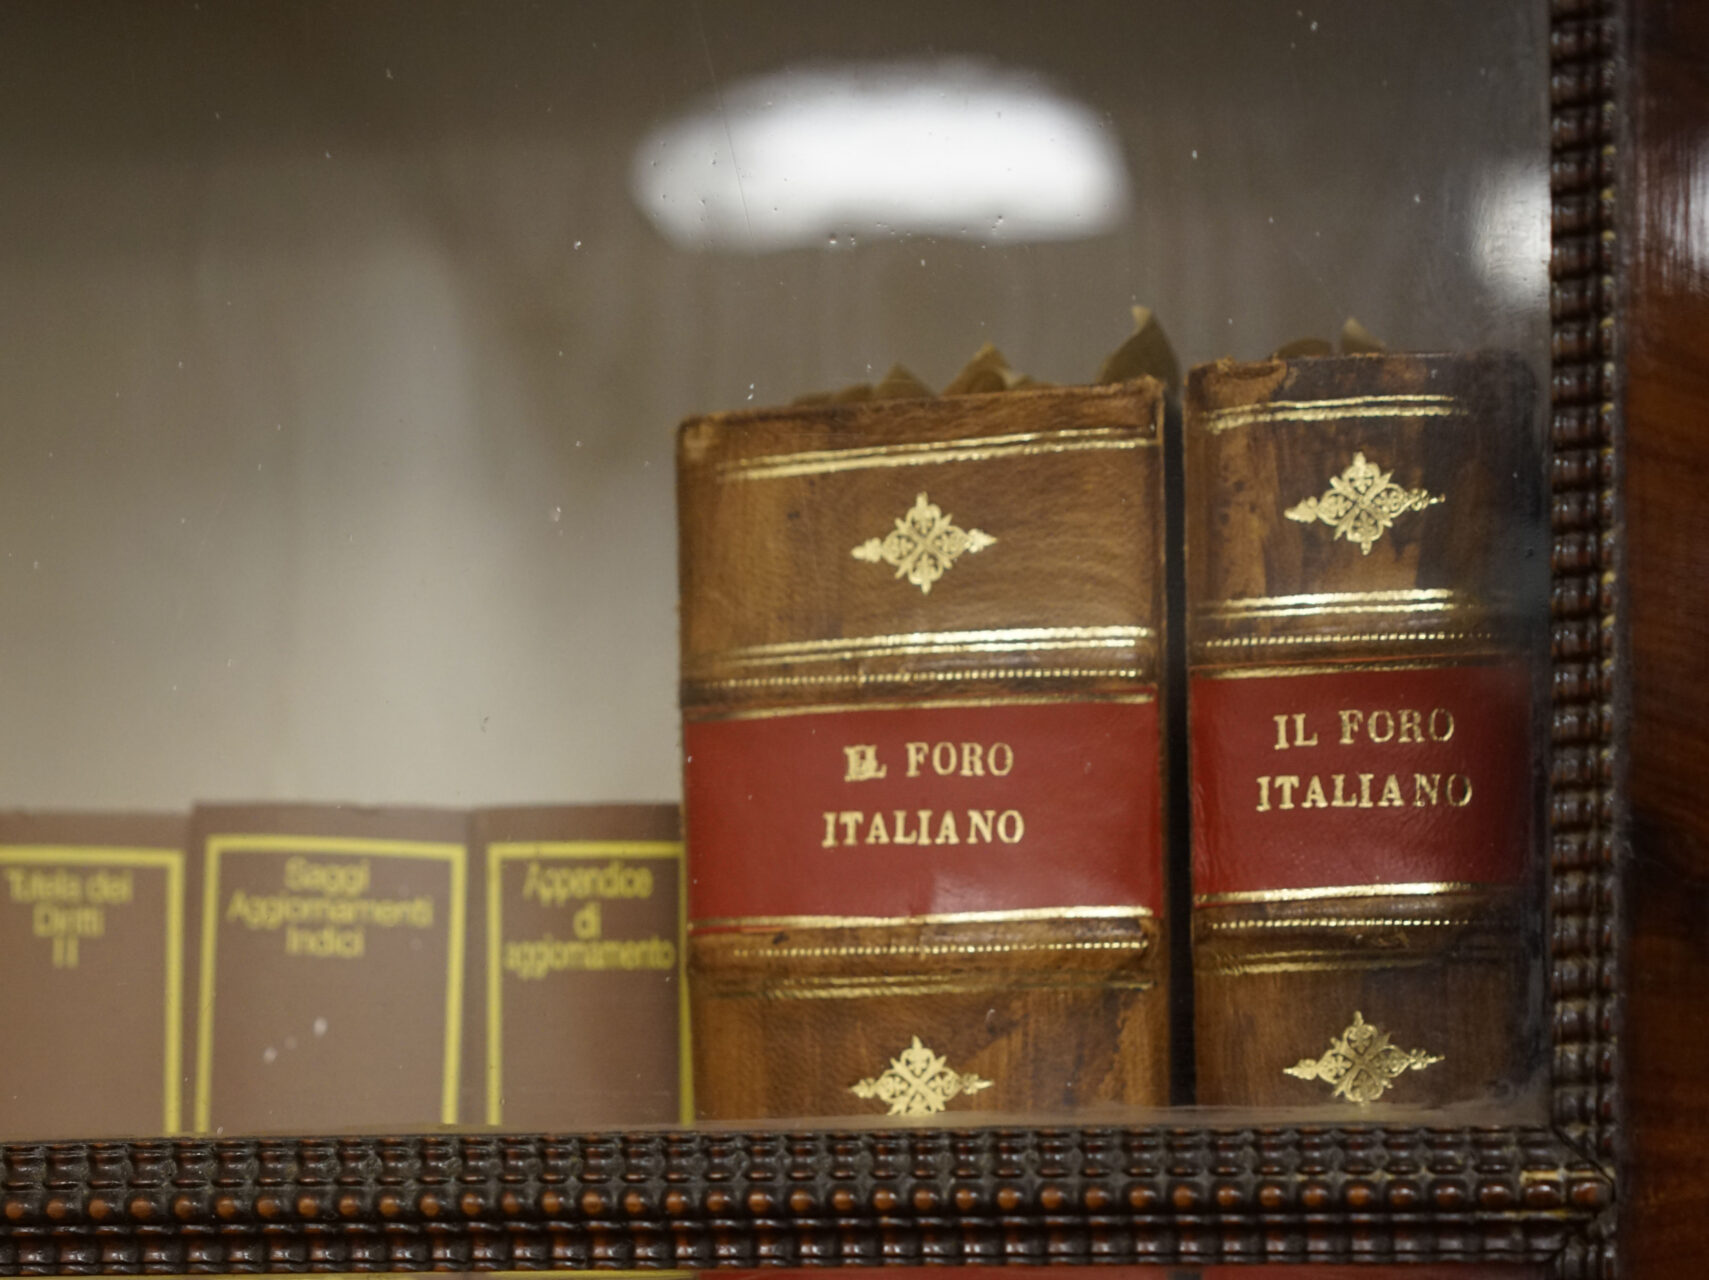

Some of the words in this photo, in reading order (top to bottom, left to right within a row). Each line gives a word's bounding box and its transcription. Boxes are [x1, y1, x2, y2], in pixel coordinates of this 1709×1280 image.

[1273, 713, 1318, 750] IL
[1338, 708, 1454, 744] FORO
[905, 742, 1013, 777] FORO
[1256, 773, 1472, 812] ITALIANO
[822, 809, 1024, 848] ITALIANO
